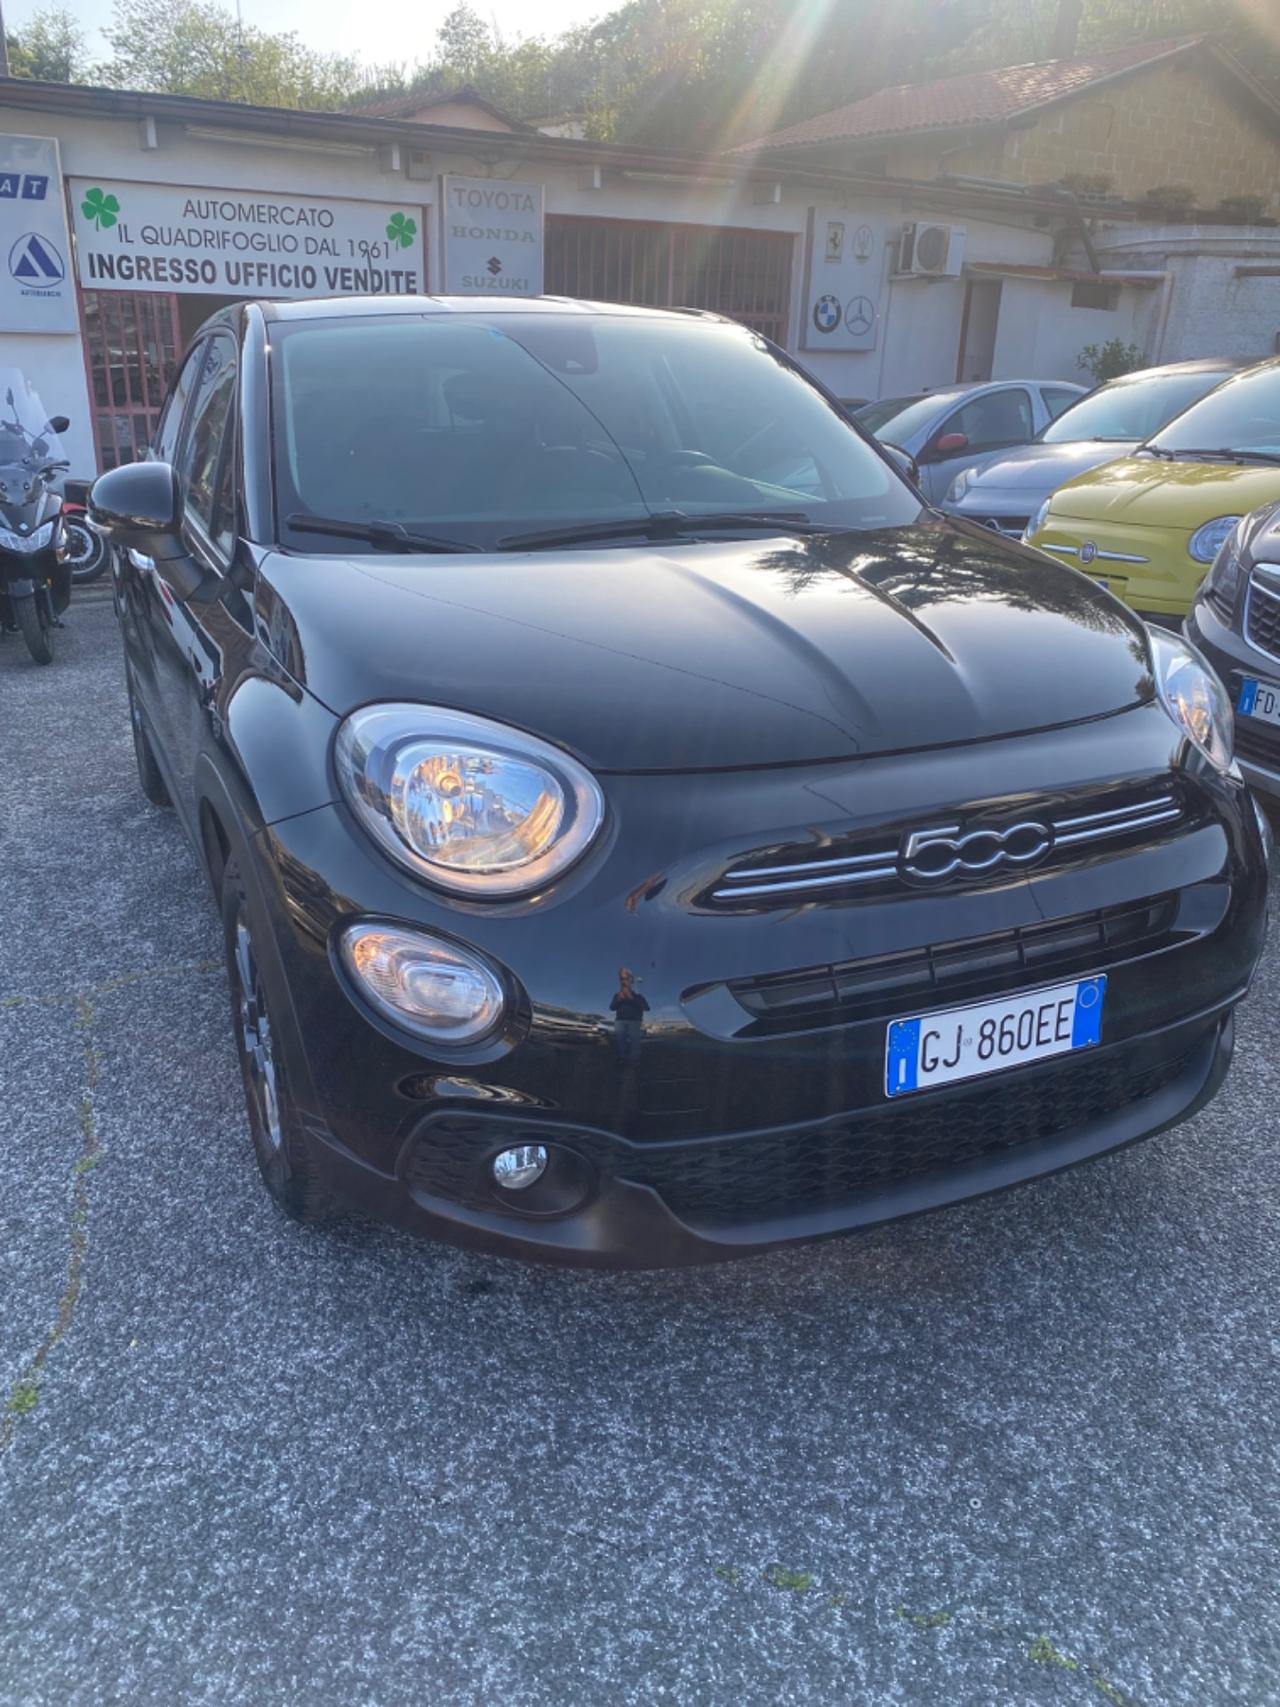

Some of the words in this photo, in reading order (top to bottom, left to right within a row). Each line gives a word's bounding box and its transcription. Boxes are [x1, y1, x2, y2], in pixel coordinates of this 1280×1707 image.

[182, 199, 334, 228] AUTOMERCATO
[453, 187, 535, 212] TOYOTA
[117, 224, 134, 243] IL
[140, 225, 298, 253] QUADRIFOGLIO
[305, 236, 341, 257] DAL
[349, 239, 390, 260] 1961
[451, 226, 536, 244] HONDA
[88, 253, 216, 284] INGRESSO
[225, 261, 316, 290] UFFICIO
[324, 265, 417, 294] VENDITE
[461, 275, 529, 291] SUZUKI
[904, 822, 1050, 877] 500
[921, 1024, 963, 1073] GJ
[977, 998, 1074, 1060] 860EE
